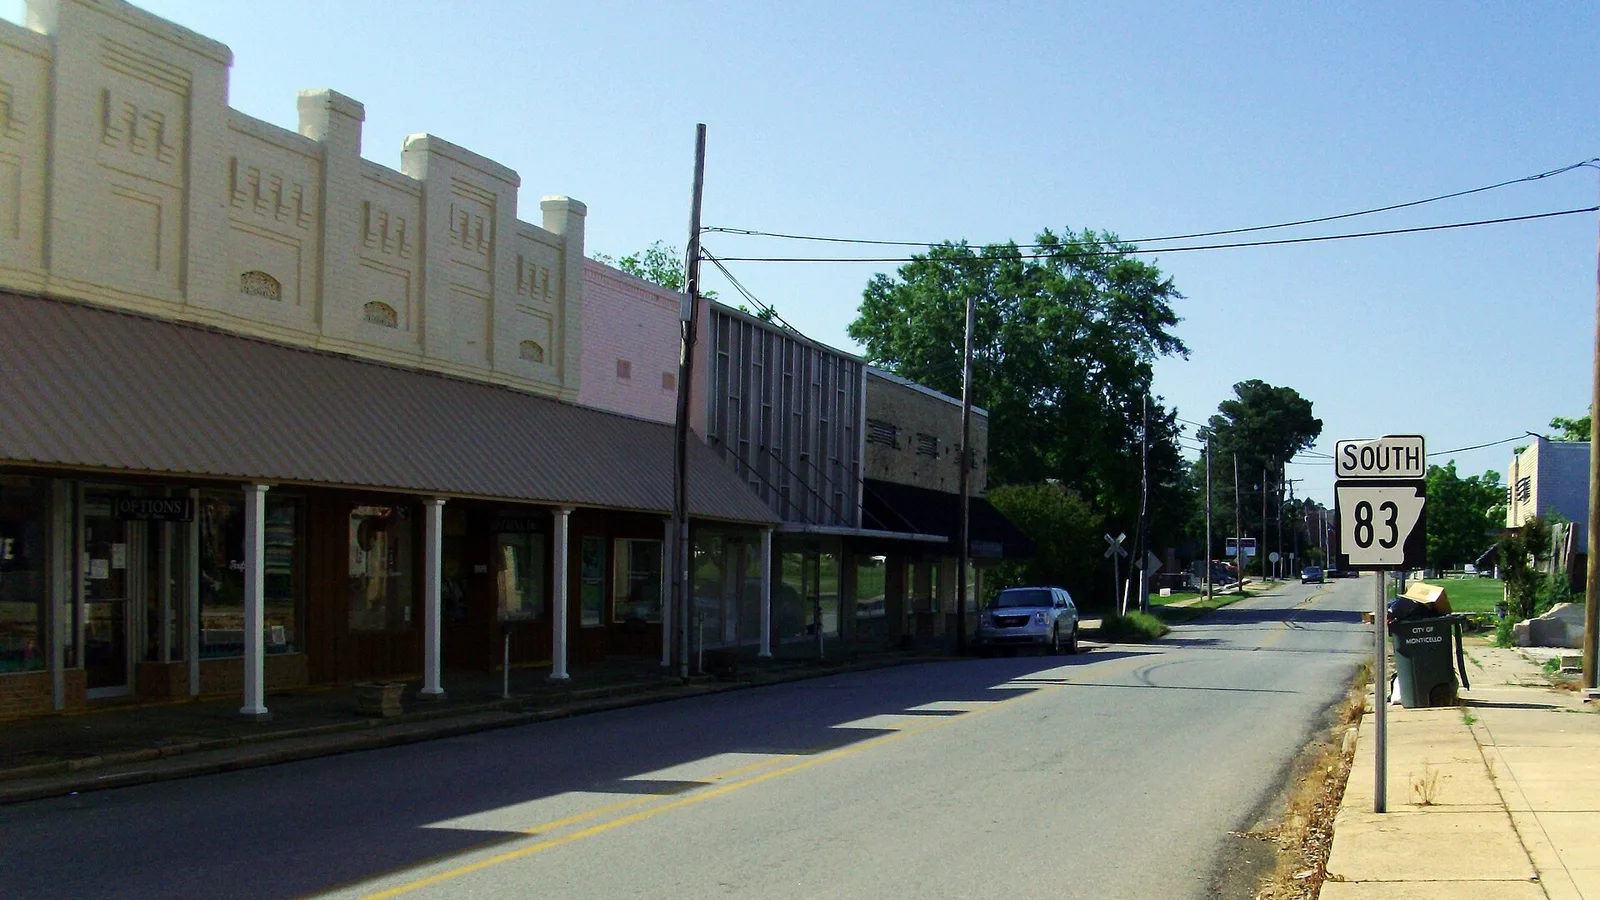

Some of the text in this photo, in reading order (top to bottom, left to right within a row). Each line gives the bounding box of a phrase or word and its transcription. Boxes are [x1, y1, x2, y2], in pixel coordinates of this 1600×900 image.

[1342, 444, 1419, 470] SOUTH
[120, 499, 181, 513] OPTIONS
[1354, 501, 1398, 548] 83
[1406, 636, 1442, 644] MONTICELLO
